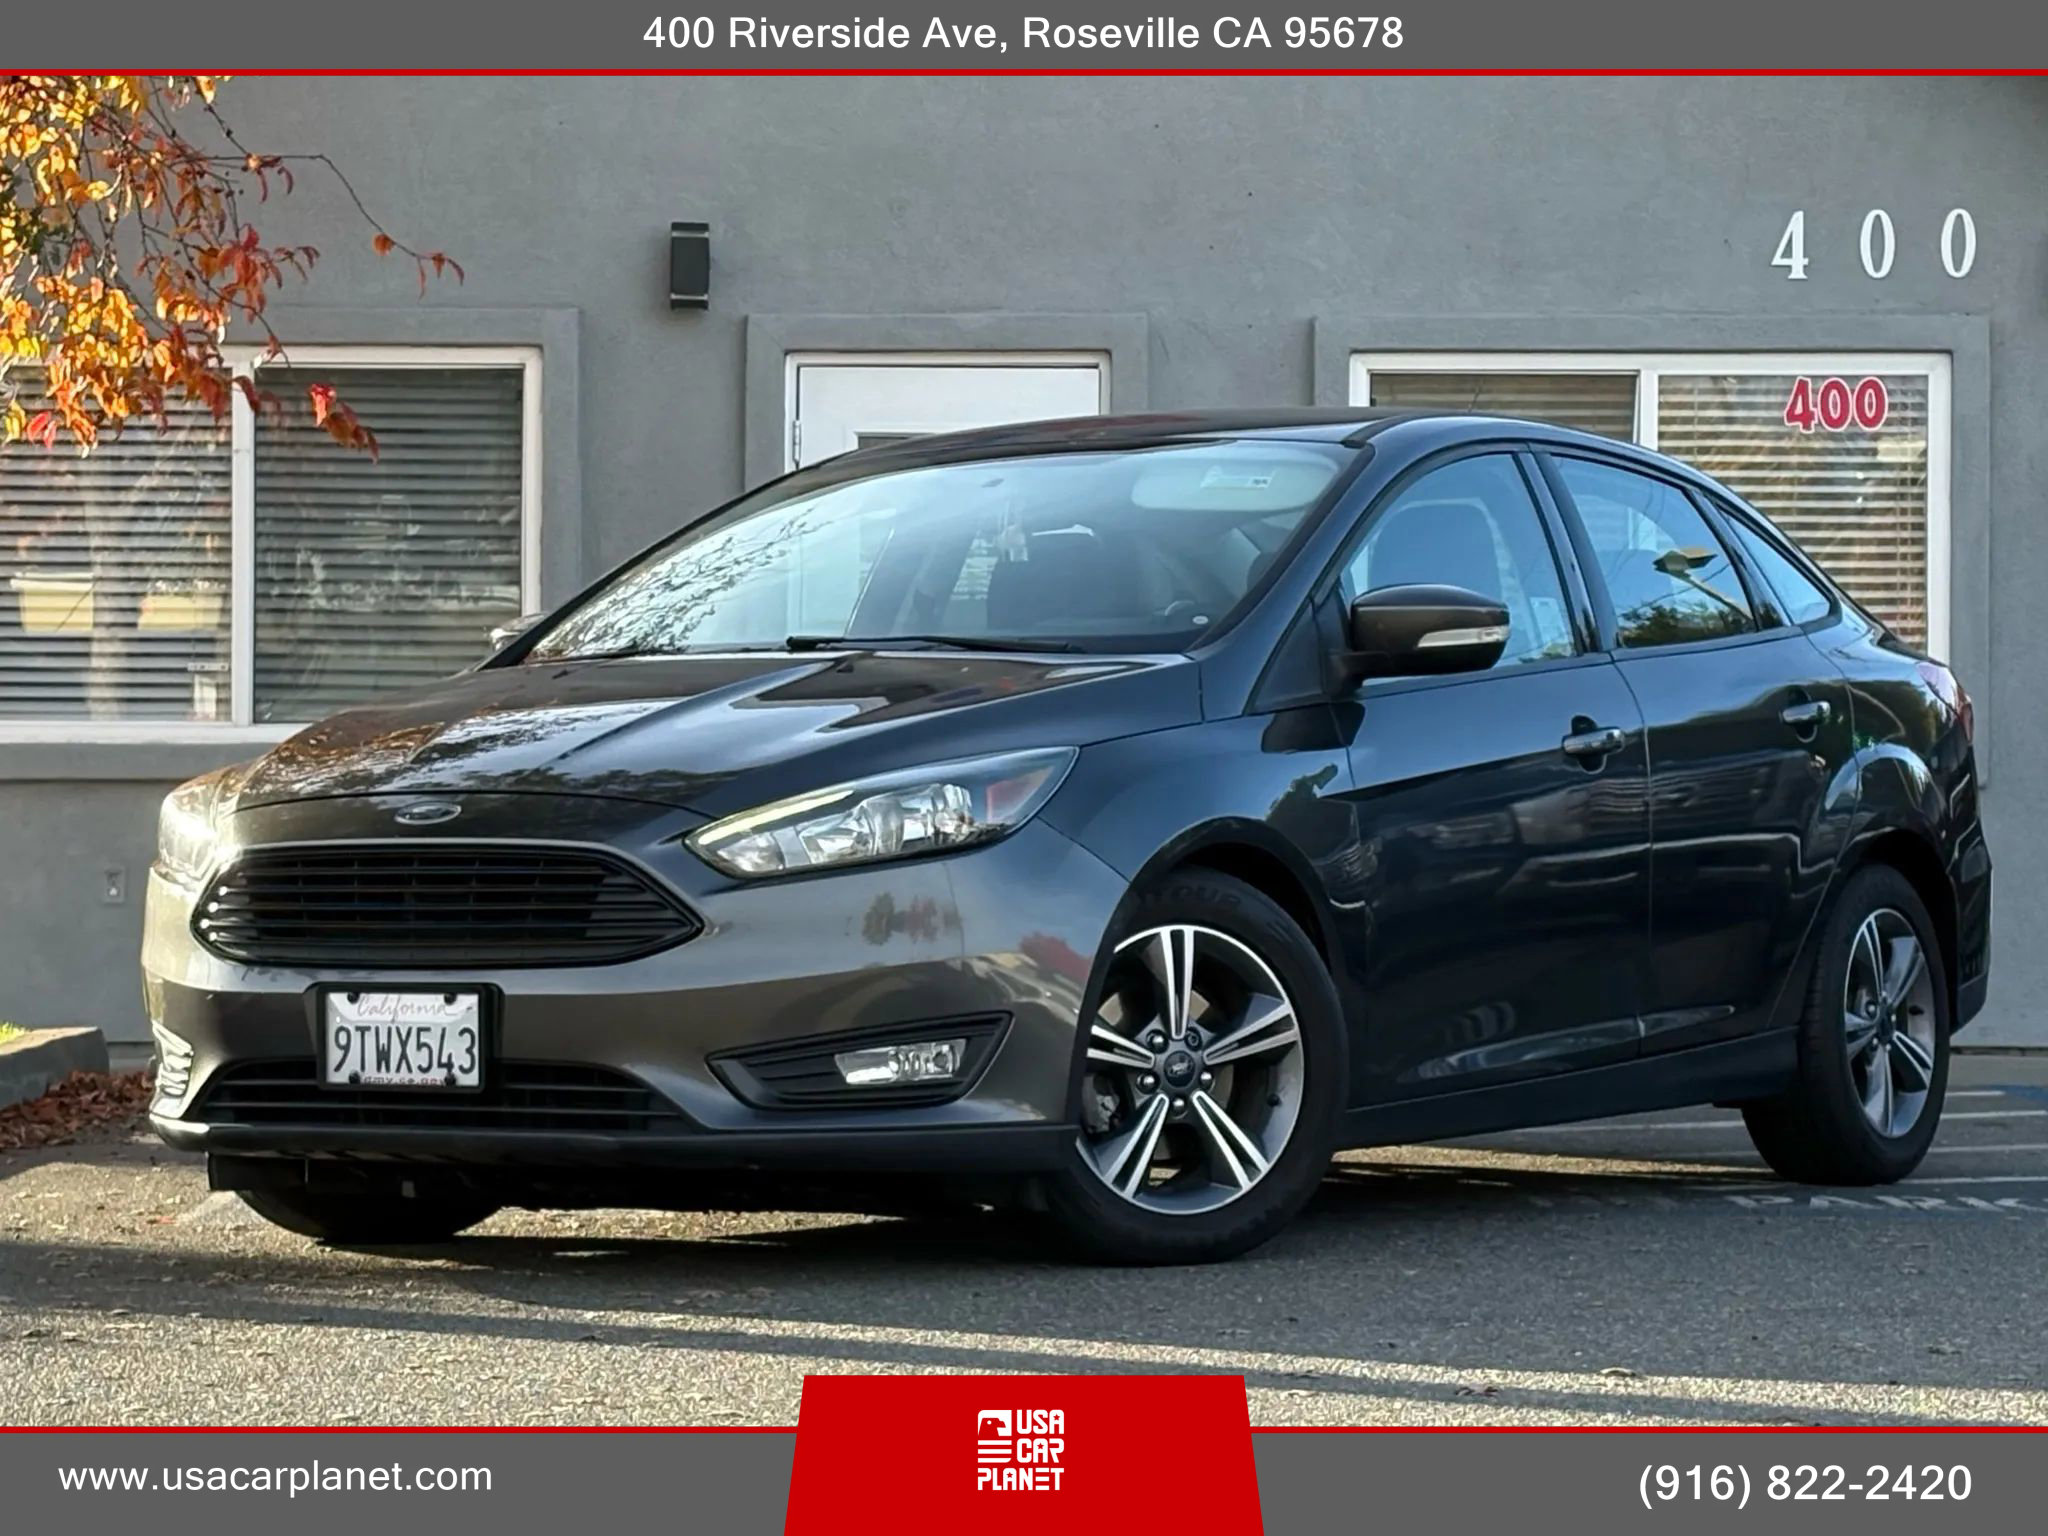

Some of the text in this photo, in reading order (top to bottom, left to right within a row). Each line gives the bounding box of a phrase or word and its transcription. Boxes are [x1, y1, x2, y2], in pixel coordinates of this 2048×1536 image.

[1771, 208, 1978, 279] 400
[1784, 376, 1889, 433] 400
[357, 993, 458, 1024] California
[333, 1024, 477, 1075] 9TWX543
[1723, 1193, 2048, 1211] PARK
